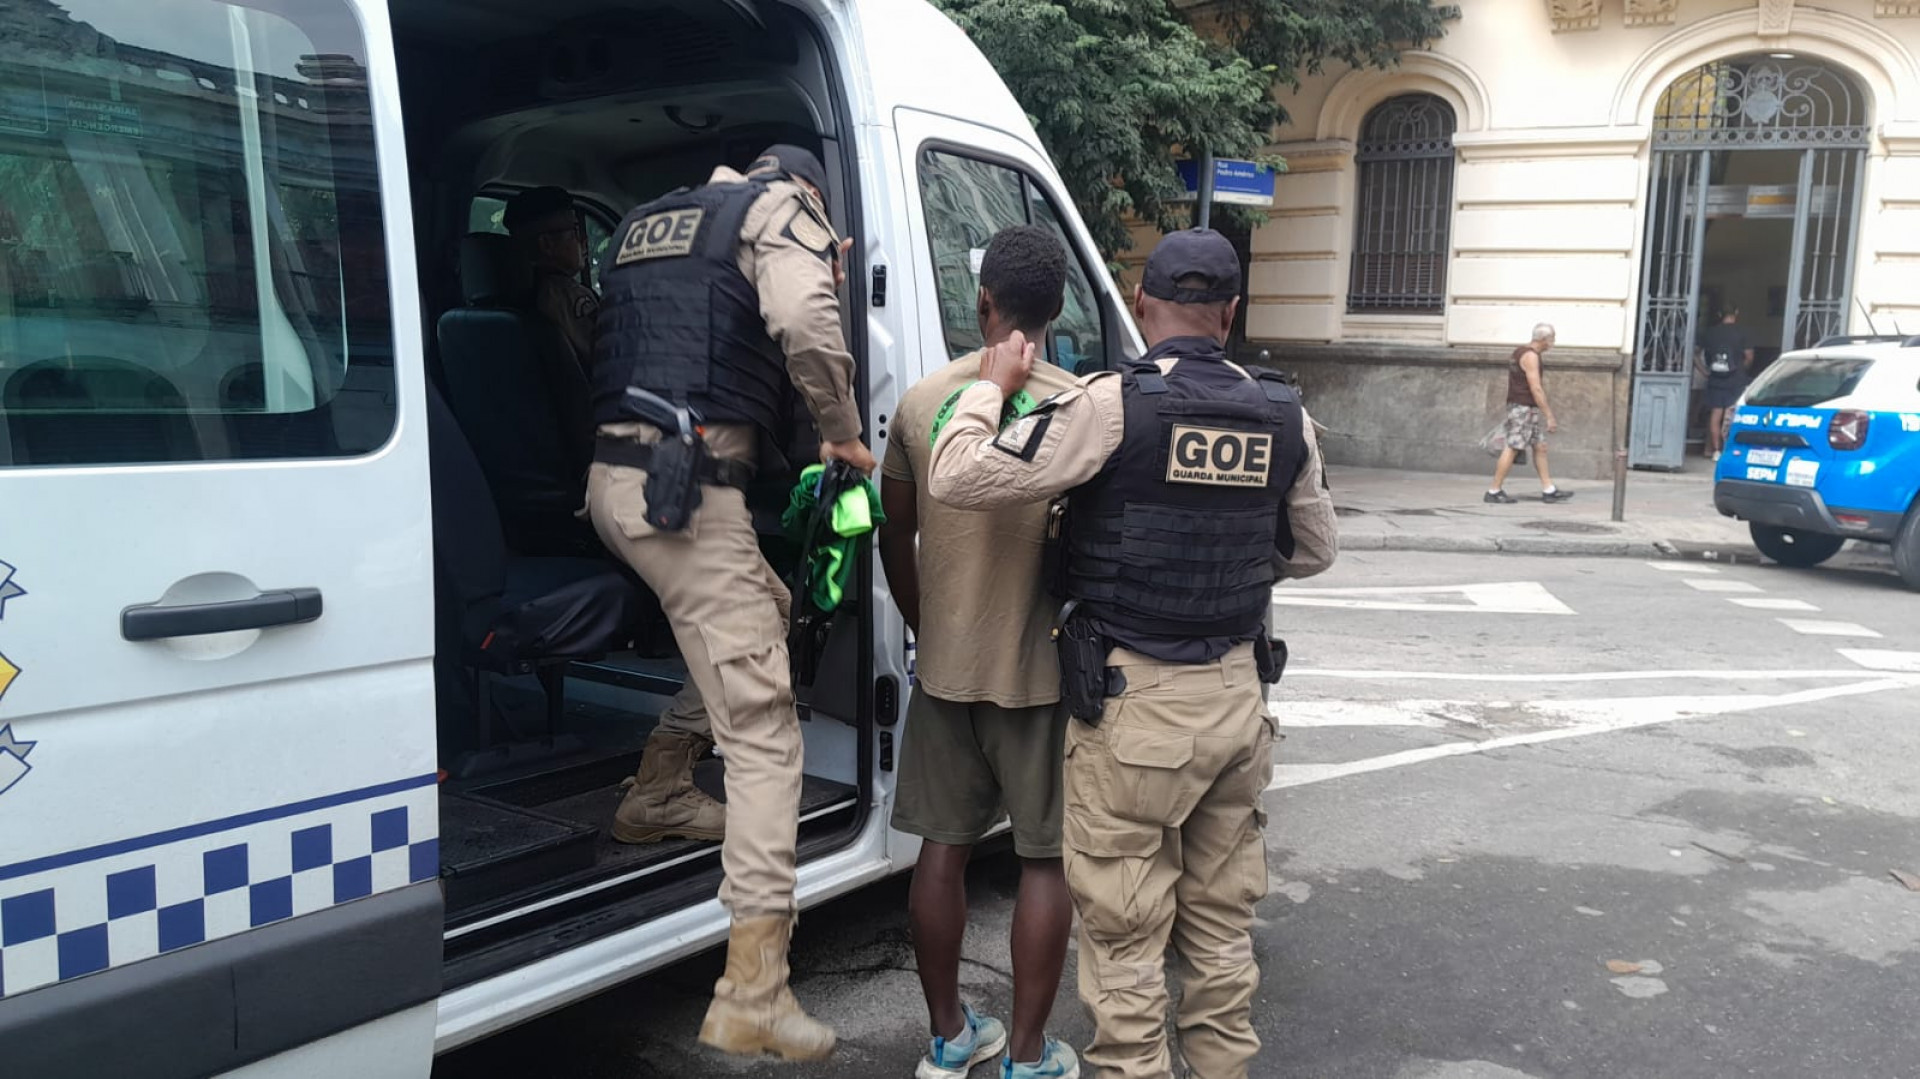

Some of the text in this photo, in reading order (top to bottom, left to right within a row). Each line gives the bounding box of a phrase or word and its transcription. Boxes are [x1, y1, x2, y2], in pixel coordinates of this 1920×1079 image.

[625, 214, 698, 250] GOE
[645, 245, 686, 253] MUNICIPAL
[1176, 431, 1269, 472] GOE
[1172, 469, 1265, 484] GUARDA MUNICIPAL
